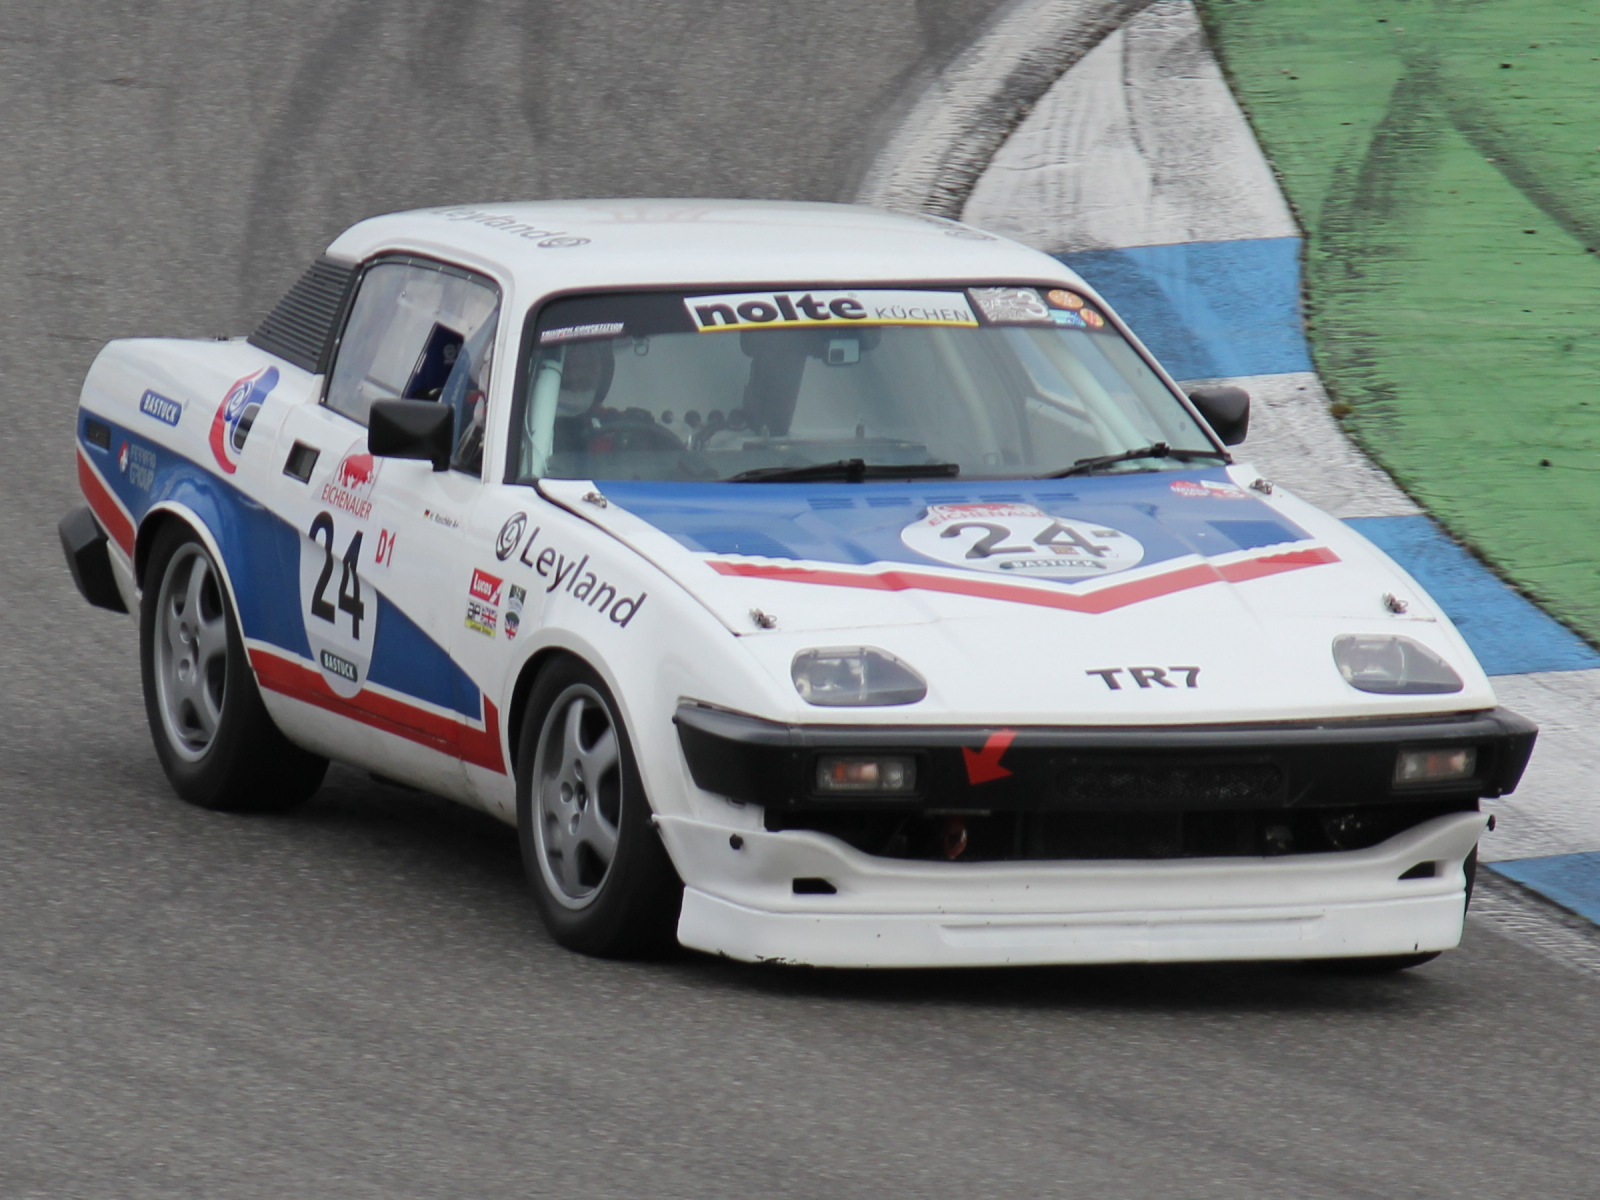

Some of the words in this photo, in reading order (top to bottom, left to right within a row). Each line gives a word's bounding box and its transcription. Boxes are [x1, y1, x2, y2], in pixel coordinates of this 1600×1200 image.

[694, 293, 867, 327] nolte
[874, 306, 970, 321] KÜCHEN
[1017, 290, 1048, 317] 3
[143, 393, 178, 423] BASTUCK
[321, 483, 372, 521] EICHENAUER
[375, 528, 396, 568] D1
[939, 519, 1113, 559] 24
[308, 510, 364, 641] 24
[519, 526, 647, 629] Leyland
[1012, 559, 1098, 569] BASTUCK
[473, 573, 493, 597] Lucas
[323, 653, 355, 679] BASTUCK
[1085, 666, 1201, 690] TR7
